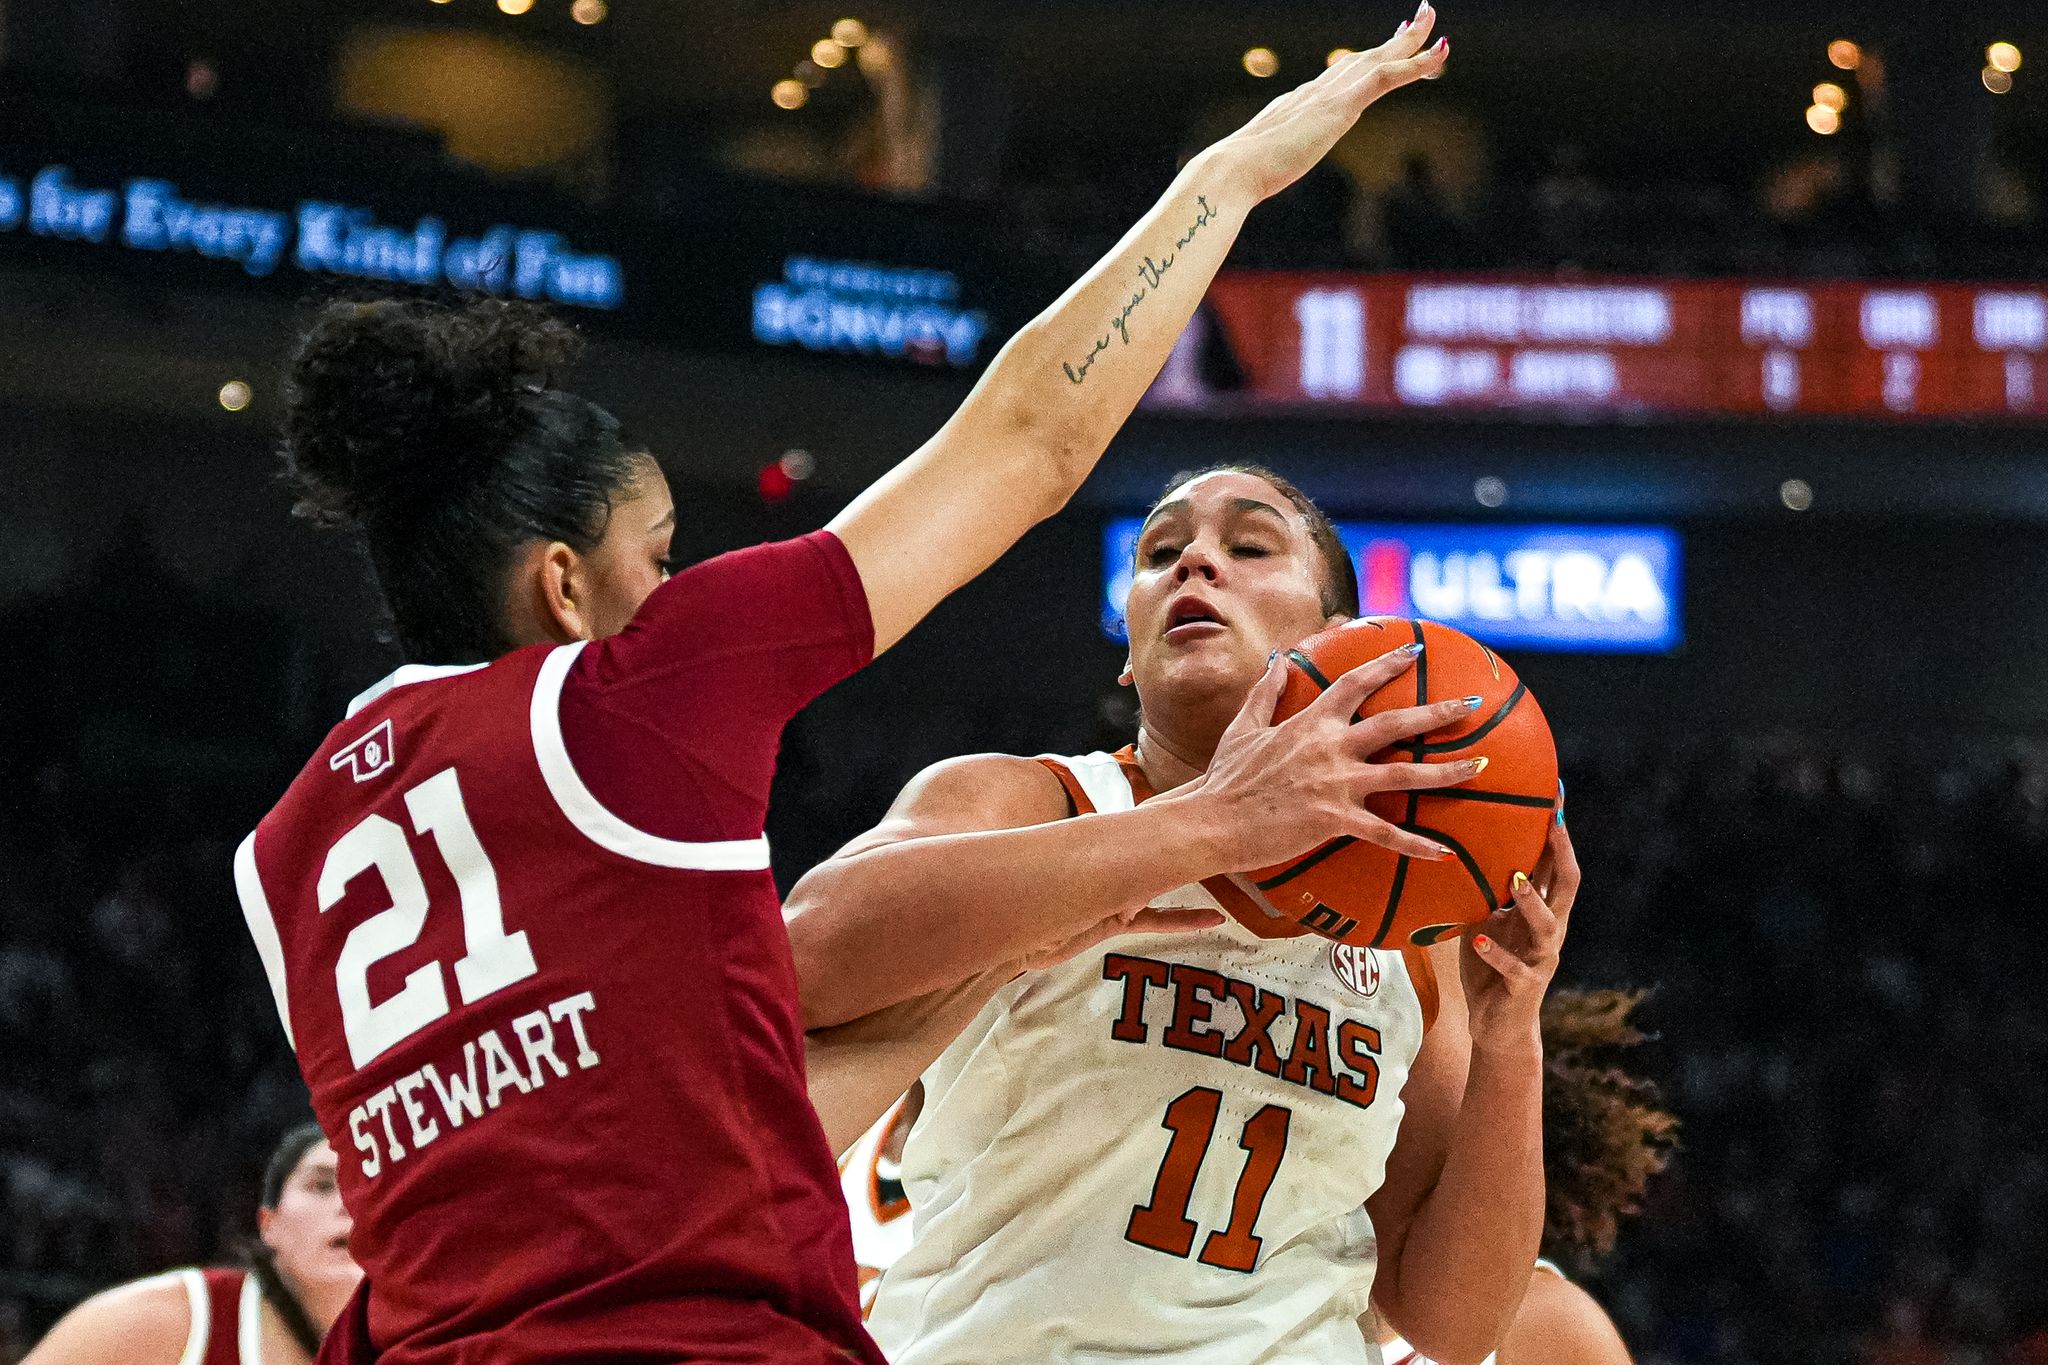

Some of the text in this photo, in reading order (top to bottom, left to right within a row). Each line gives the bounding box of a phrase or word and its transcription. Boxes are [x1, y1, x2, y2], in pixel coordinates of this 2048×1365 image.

[31, 165, 112, 240] for
[299, 201, 444, 284] Kind
[515, 230, 623, 307] Fun
[1062, 195, 1217, 385] love you the most
[1411, 548, 1667, 621] ULTRA
[317, 766, 537, 1070] 21
[1334, 944, 1380, 996] SEC
[348, 991, 600, 1178] STEWART
[1102, 953, 1382, 1109] TEXAS
[1124, 1086, 1292, 1273] 11
